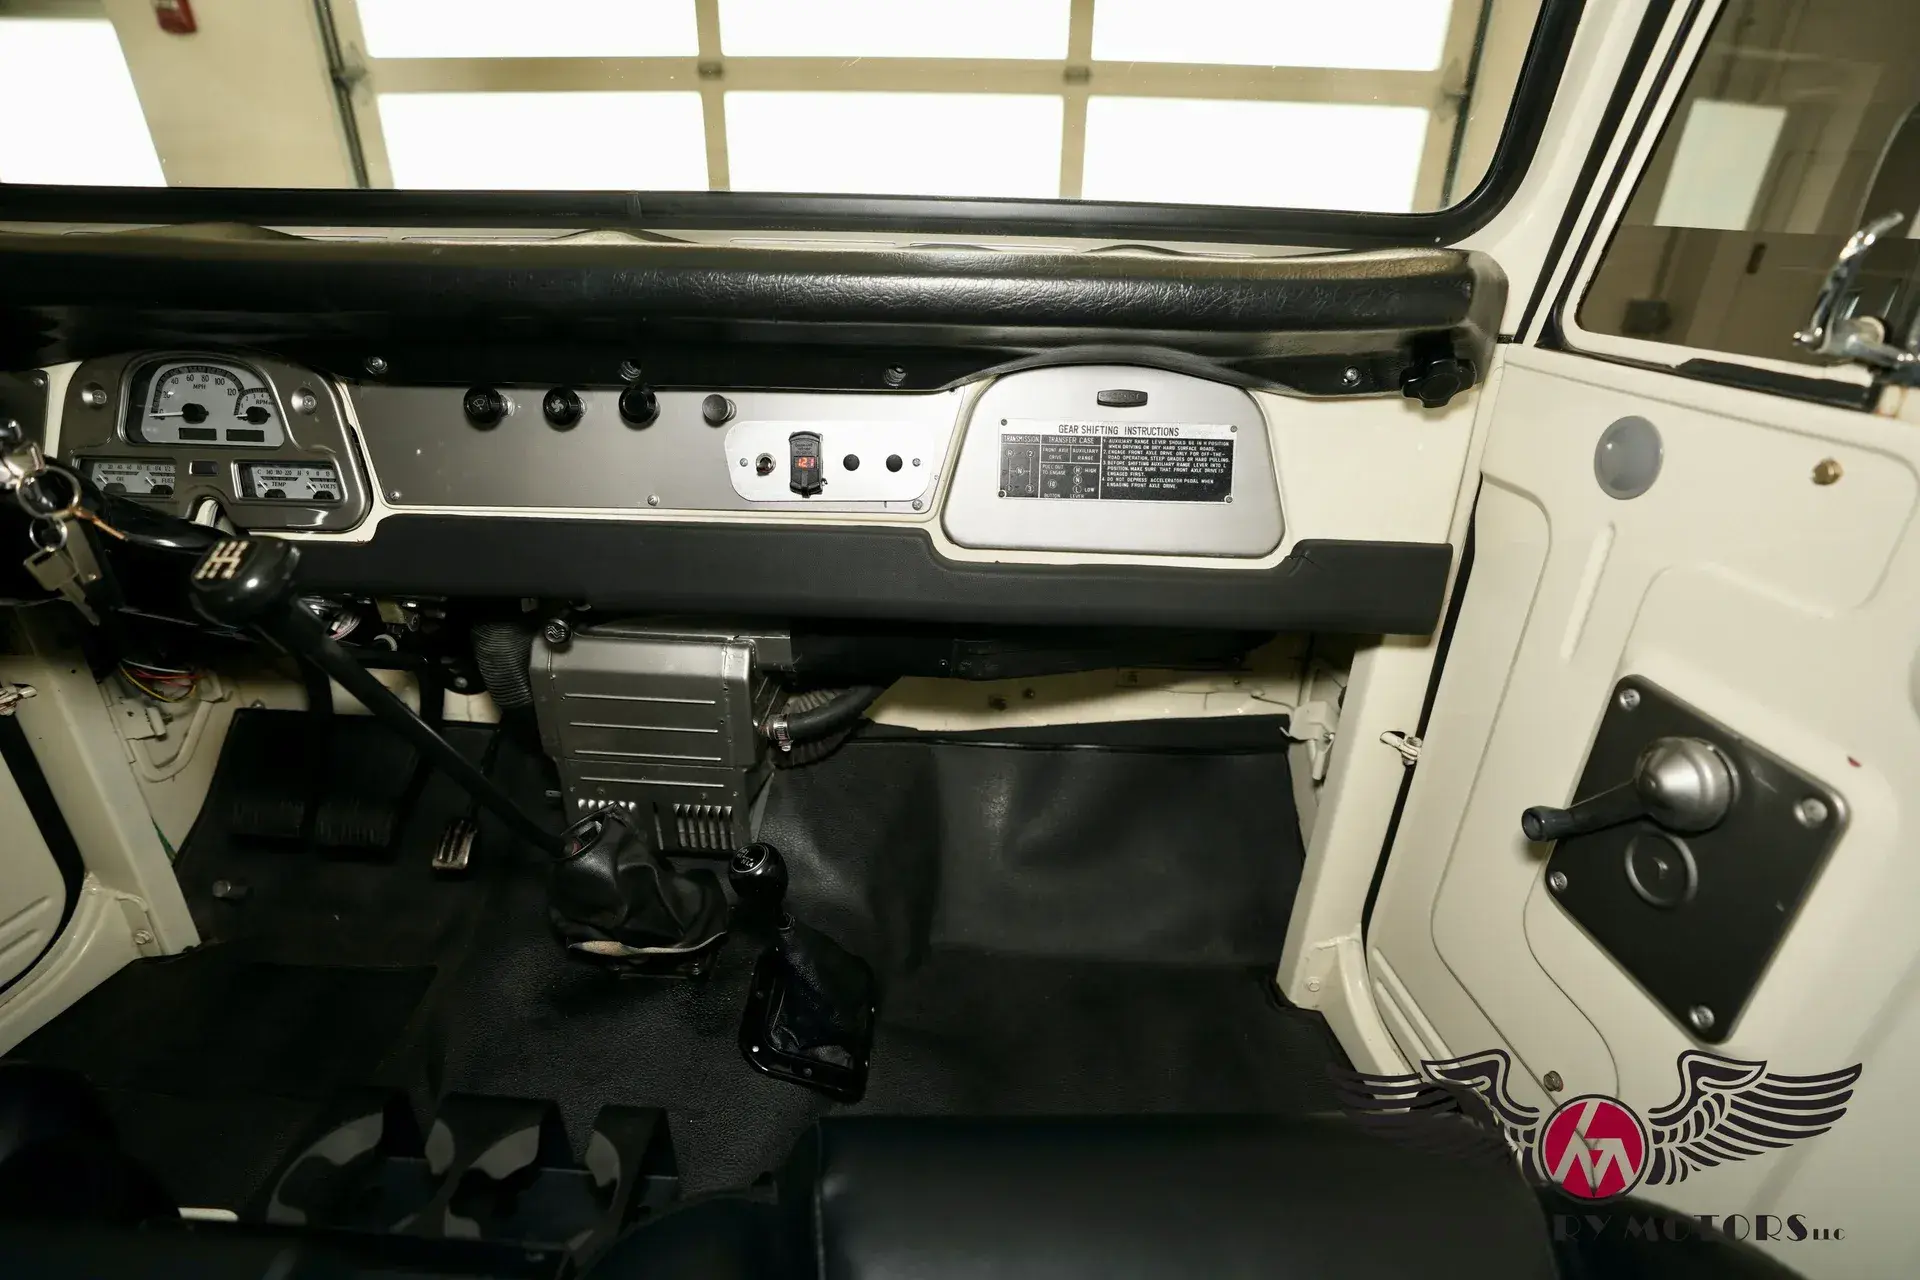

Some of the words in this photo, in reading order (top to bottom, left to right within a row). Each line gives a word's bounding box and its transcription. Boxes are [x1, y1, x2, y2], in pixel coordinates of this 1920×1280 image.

[1058, 424, 1078, 434] GEAR
[1081, 425, 1119, 435] SHIFTING
[1124, 426, 1180, 436] INSTRUCTIONS
